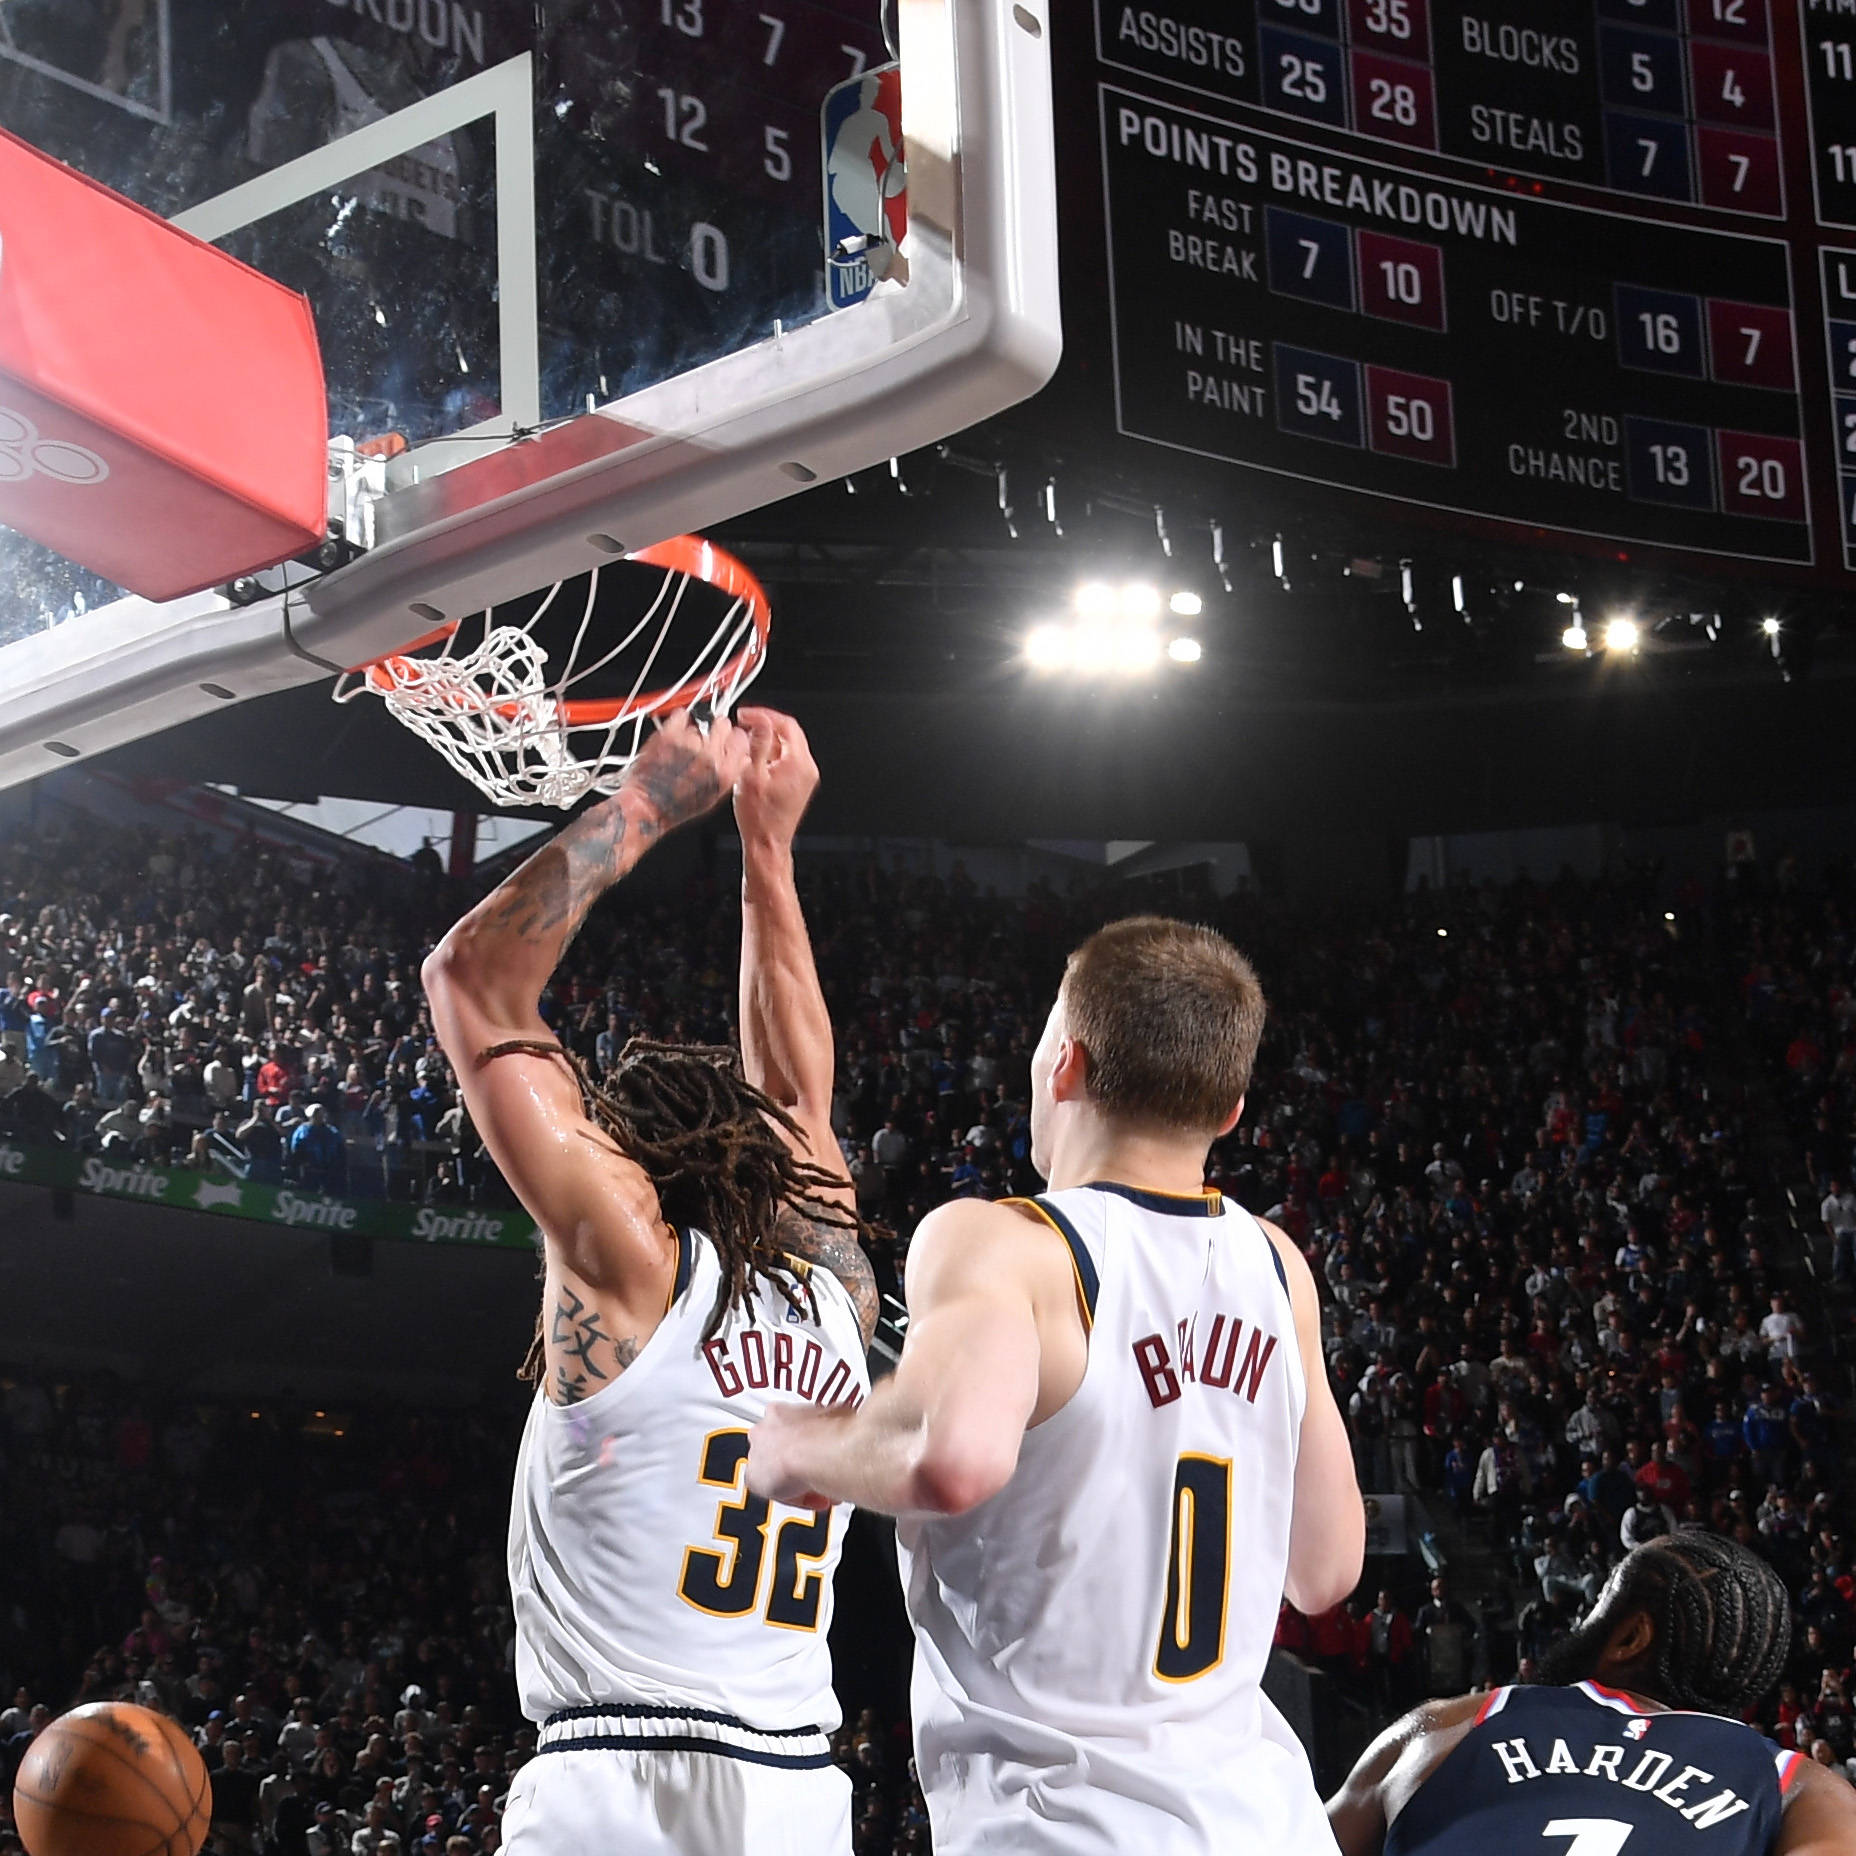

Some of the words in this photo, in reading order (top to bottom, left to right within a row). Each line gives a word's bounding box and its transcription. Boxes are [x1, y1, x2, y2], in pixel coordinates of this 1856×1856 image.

[759, 13, 785, 66] 7
[1118, 6, 1245, 78] ASSISTS
[1279, 53, 1327, 104] 25
[1369, 76, 1417, 128] 28
[1461, 15, 1580, 75] BLOCKS
[1631, 53, 1655, 92] 5
[1721, 69, 1746, 108] 4
[657, 88, 709, 152] 12
[763, 124, 792, 182] 5
[1470, 104, 1585, 161] STEALS
[1637, 138, 1661, 178] 7
[1728, 153, 1751, 194] 7
[1118, 107, 1257, 183] POINTS
[1270, 155, 1517, 246] BREAKDOWN
[1187, 190, 1254, 236] FAST
[584, 187, 665, 264] TOL
[691, 222, 729, 292] 0
[1168, 233, 1257, 283] BREAK
[1297, 239, 1321, 280] 7
[1379, 260, 1422, 305] 10
[1175, 321, 1203, 355] IN
[1214, 332, 1264, 372] THE
[1491, 290, 1543, 328] OFF
[1552, 299, 1607, 342] T/O
[1638, 311, 1681, 354] 16
[1739, 327, 1761, 367] 7
[1186, 371, 1266, 418] PAINT
[1296, 374, 1342, 421] 54
[1386, 395, 1432, 441] 50
[1563, 410, 1619, 447] 2ND
[1508, 443, 1621, 493] CHANCE
[1650, 444, 1689, 487] 13
[1737, 457, 1786, 501] 20
[79, 1157, 171, 1200] Sprite
[272, 1191, 357, 1230] Sprite
[412, 1208, 503, 1243] Sprite
[677, 1427, 832, 1632] 32
[1151, 1450, 1233, 1685] 0
[1491, 1737, 1749, 1830] HARDEN
